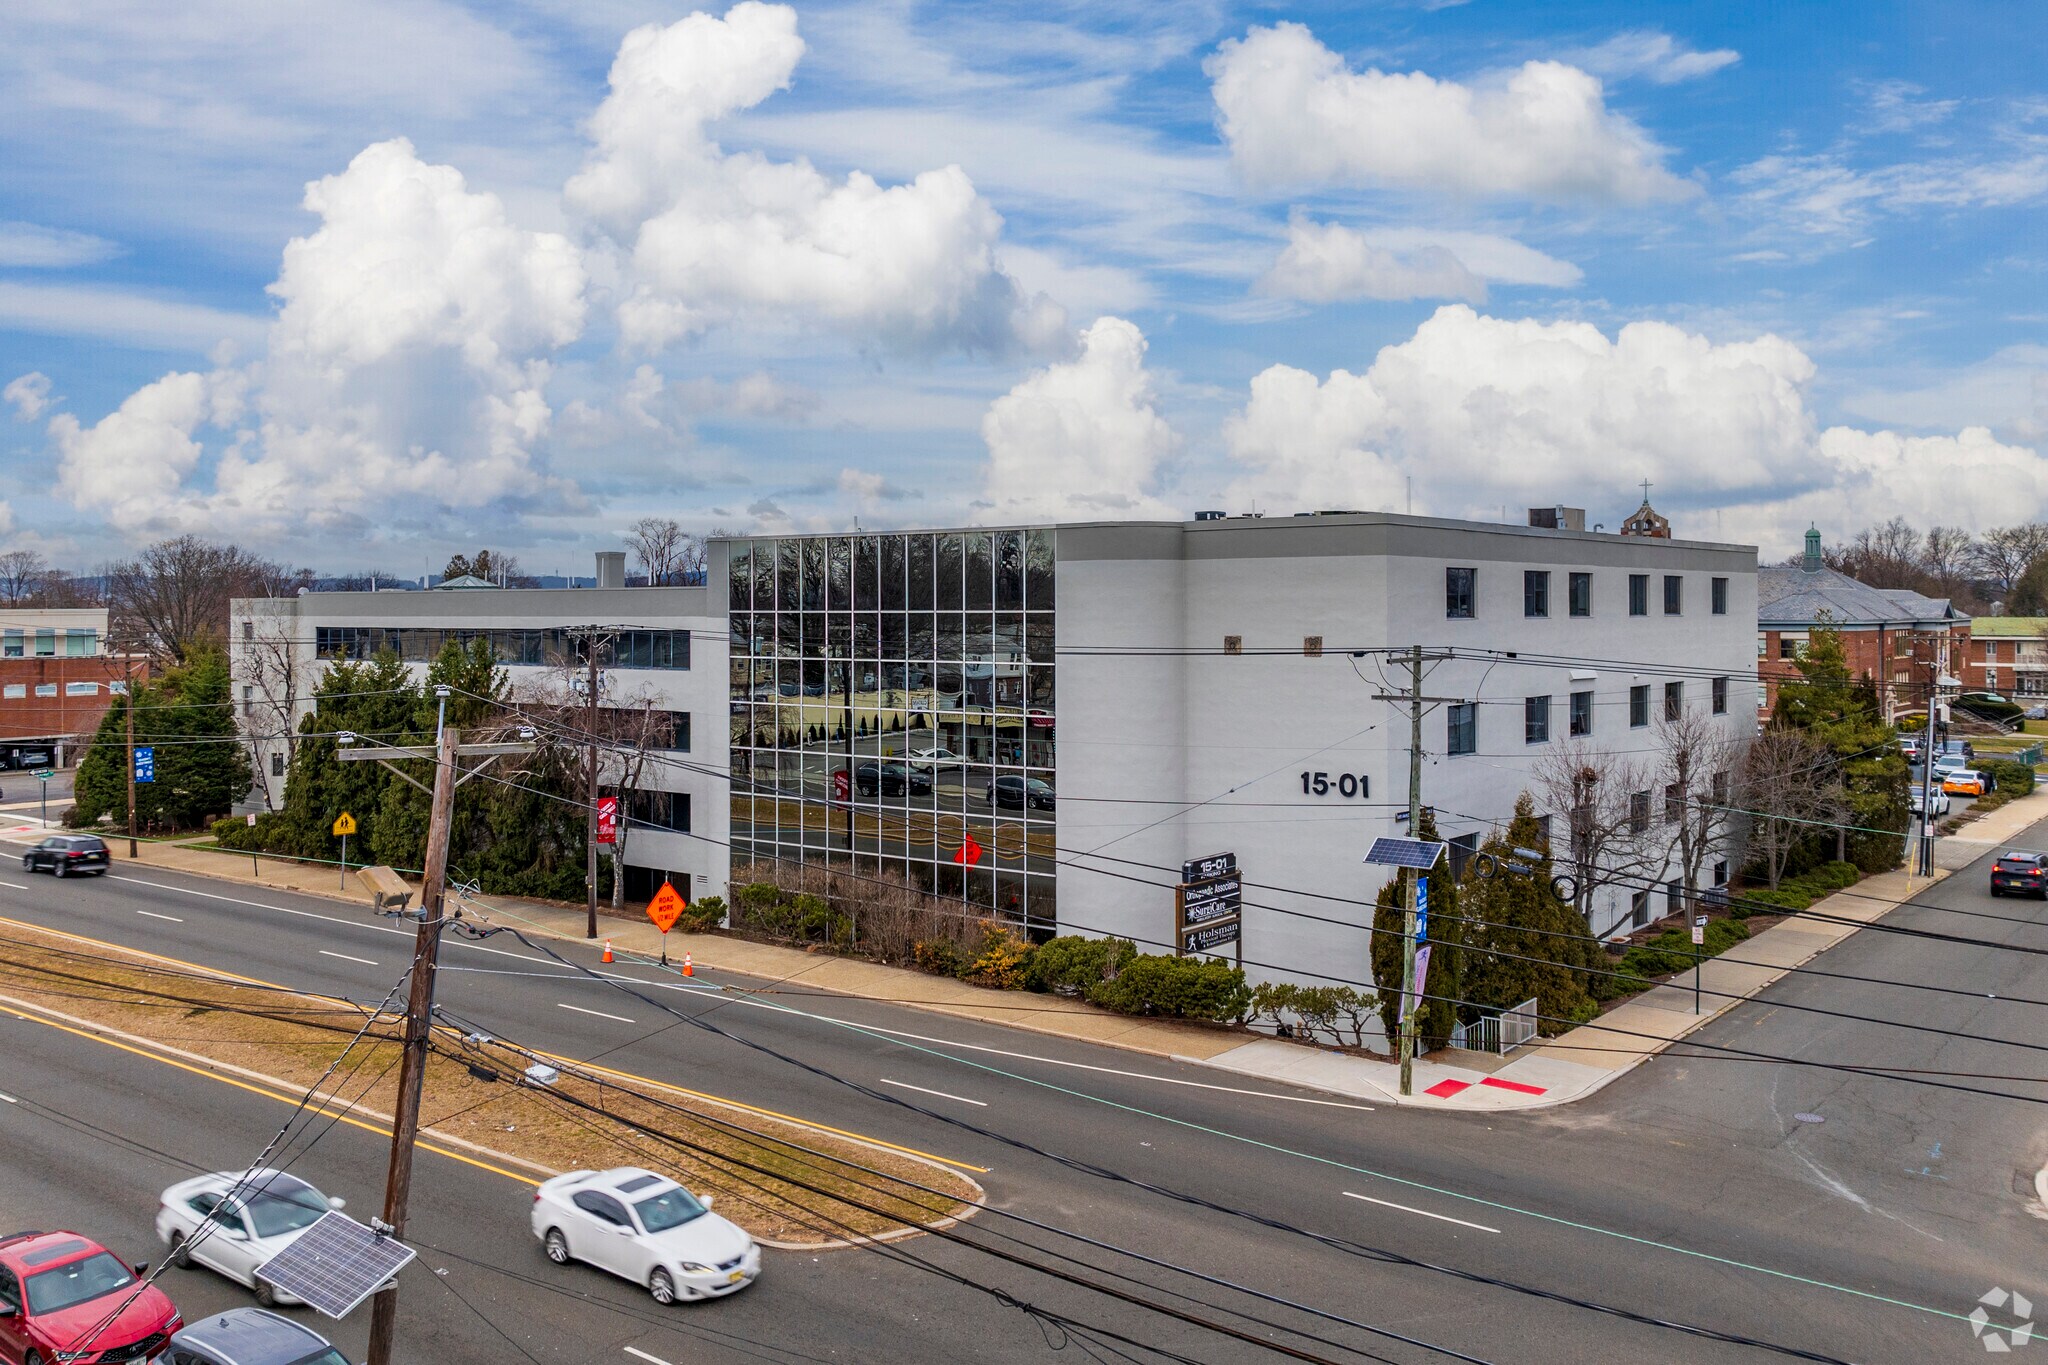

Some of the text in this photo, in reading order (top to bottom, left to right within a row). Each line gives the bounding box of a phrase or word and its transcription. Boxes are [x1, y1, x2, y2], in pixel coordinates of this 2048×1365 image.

[1300, 771, 1369, 799] 15-01
[1200, 858, 1227, 872] 15-01
[658, 895, 674, 904] ROAD
[658, 904, 674, 912] WORK
[1195, 901, 1226, 916] SurgiCare
[1198, 923, 1238, 941] Holsman
